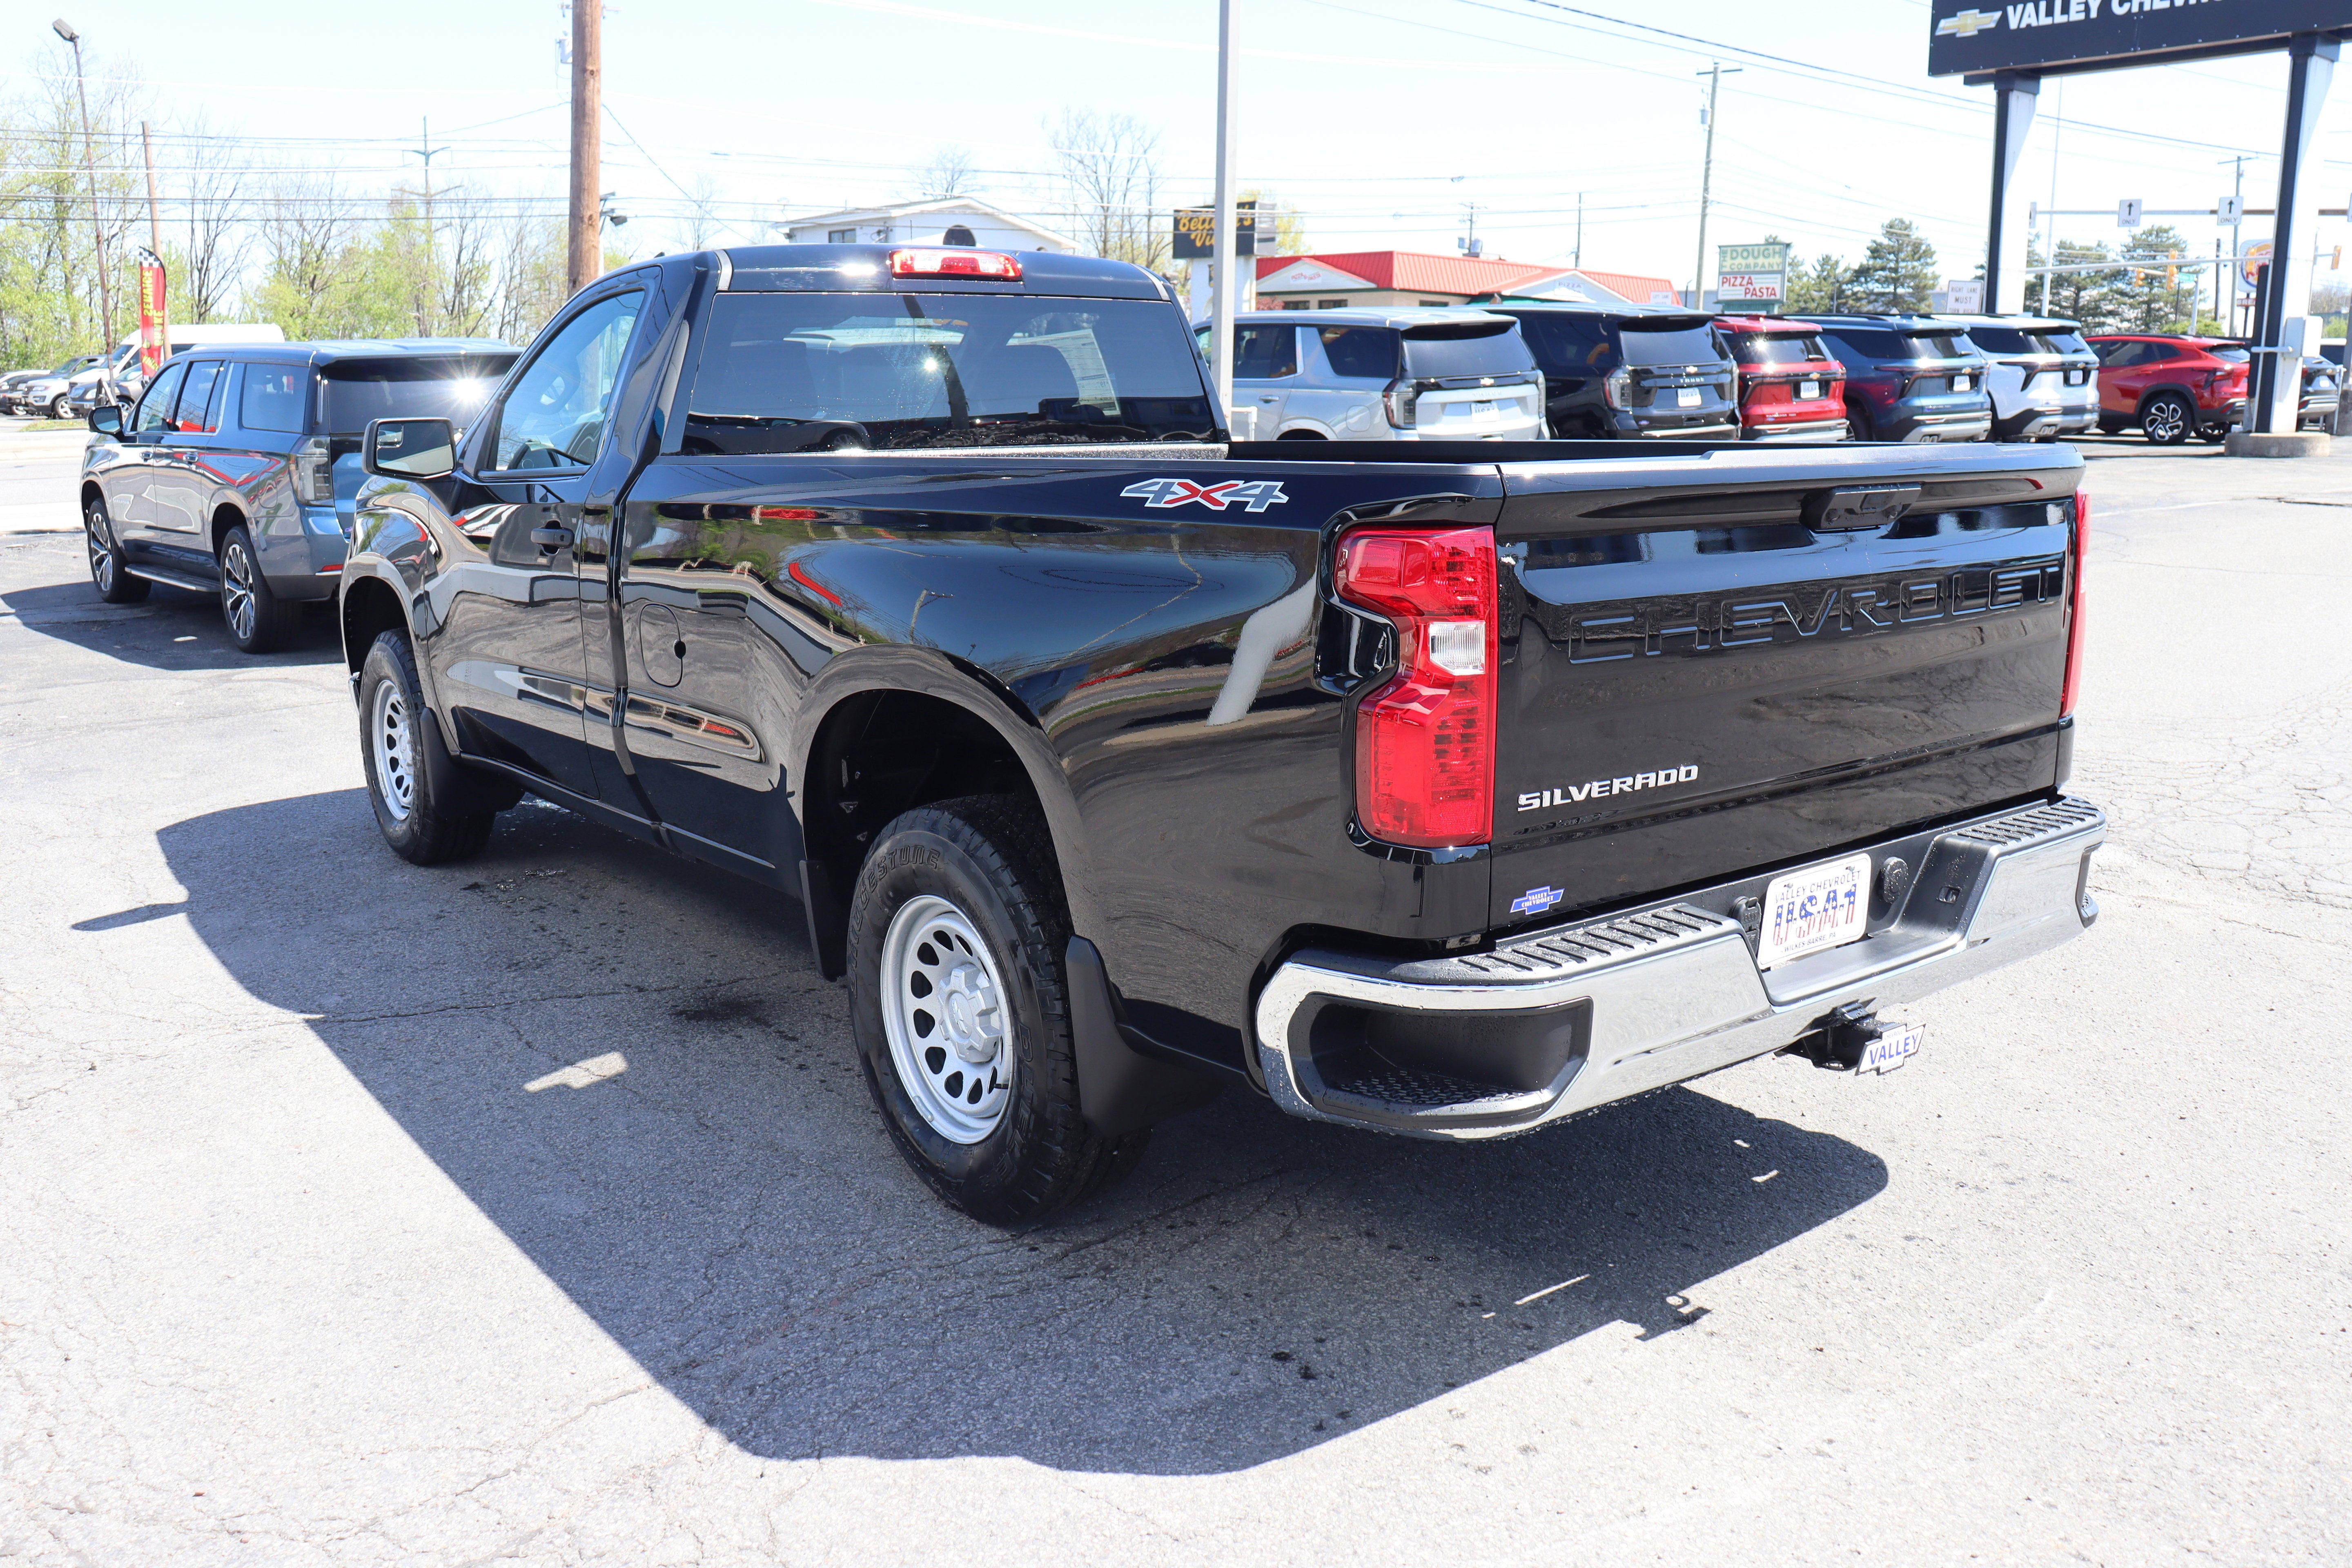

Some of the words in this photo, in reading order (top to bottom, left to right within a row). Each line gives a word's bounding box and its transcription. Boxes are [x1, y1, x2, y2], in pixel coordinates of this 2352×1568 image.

[2007, 0, 2102, 30] VALLEY
[1730, 247, 1782, 260] DOUGH
[1730, 262, 1782, 270] COMPANY
[1722, 275, 1753, 287] PIZZA
[1744, 286, 1777, 298] PASTA
[1568, 561, 2060, 664] CHEVROLET
[1517, 764, 1699, 812] SILVERADO
[1775, 886, 1807, 903] VALLEY
[1810, 870, 1861, 893] CHEVROLET
[1521, 895, 1554, 908] CHEVROLET
[1528, 892, 1548, 901] VALLEY
[1869, 1033, 1919, 1065] VALLEY
